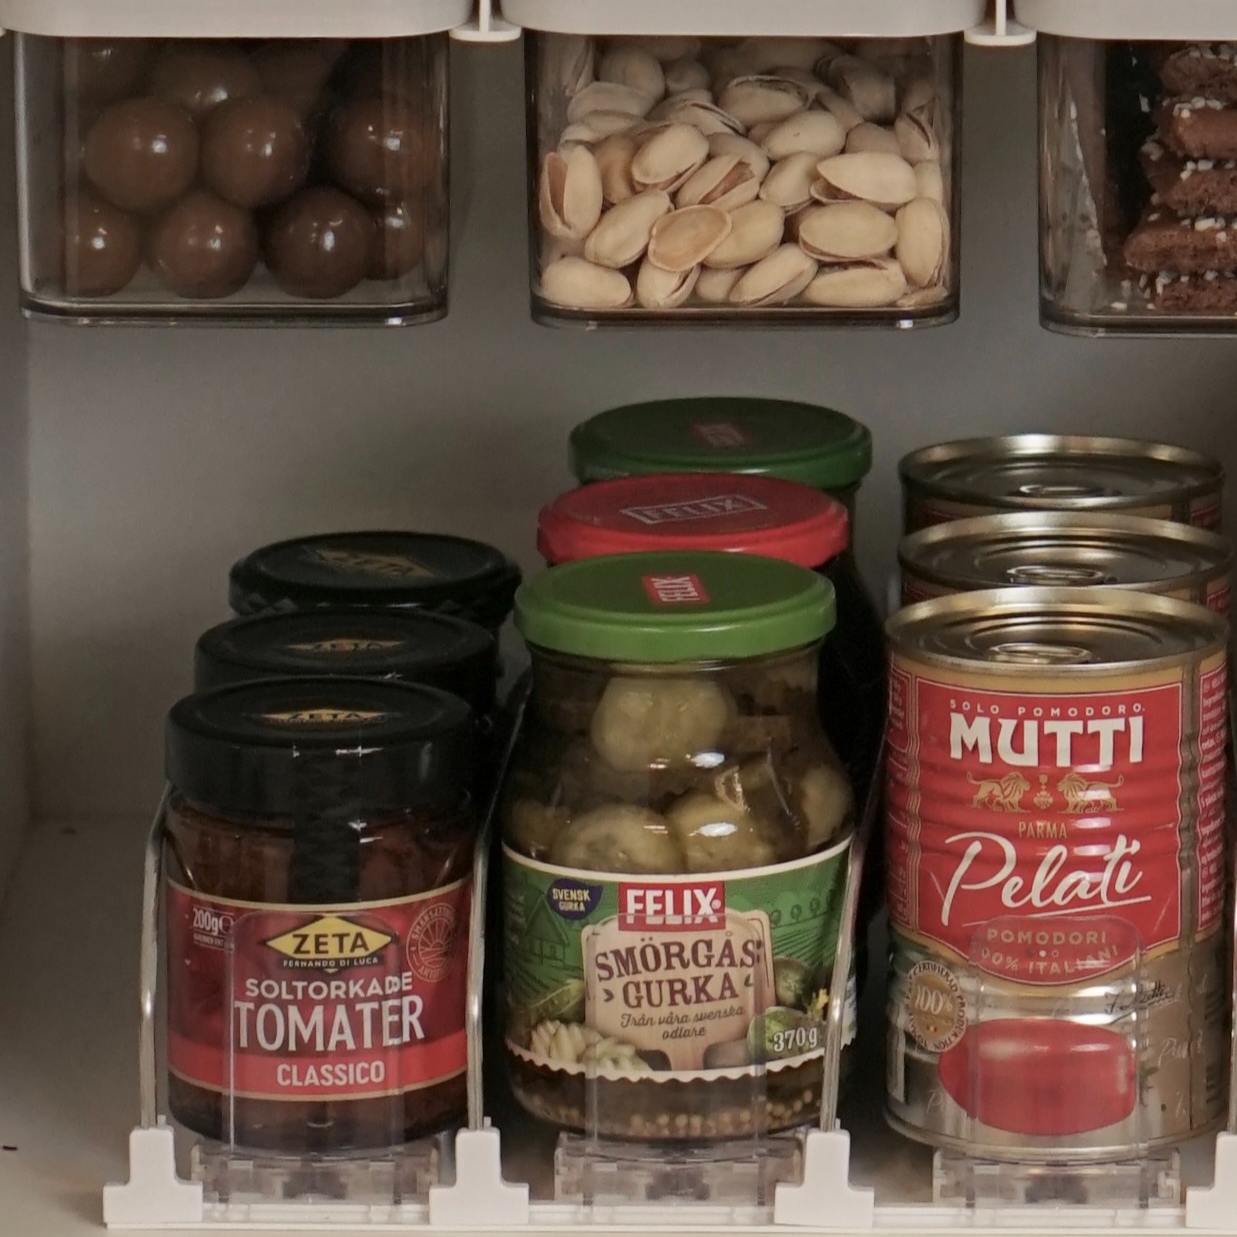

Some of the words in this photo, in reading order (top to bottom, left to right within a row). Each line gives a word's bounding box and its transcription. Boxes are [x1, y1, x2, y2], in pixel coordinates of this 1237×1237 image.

[949, 698, 1000, 715] SOLO
[1018, 702, 1143, 717] POMODORO
[949, 712, 1145, 768] MUTTI
[1018, 821, 1068, 840] PARMA
[940, 831, 1147, 927] Pelati
[552, 887, 591, 902] SVENSK
[558, 901, 586, 913] GURKA
[625, 887, 719, 925] FELIX
[291, 932, 370, 955] ZETA
[986, 928, 1107, 945] POMODORI
[282, 959, 336, 968] FERNANDO
[339, 959, 350, 967] DI
[353, 956, 379, 967] LUCA
[595, 930, 763, 983] SMÖRGÅS
[244, 971, 413, 1001] SOLTORKADE
[621, 972, 740, 1009] GURKA
[233, 994, 425, 1052] TOMATER
[620, 1011, 655, 1029] Från
[658, 1010, 691, 1025] våra
[693, 1004, 745, 1023] svenska
[661, 1025, 707, 1041] odlare
[276, 1059, 385, 1087] CLASSICO
